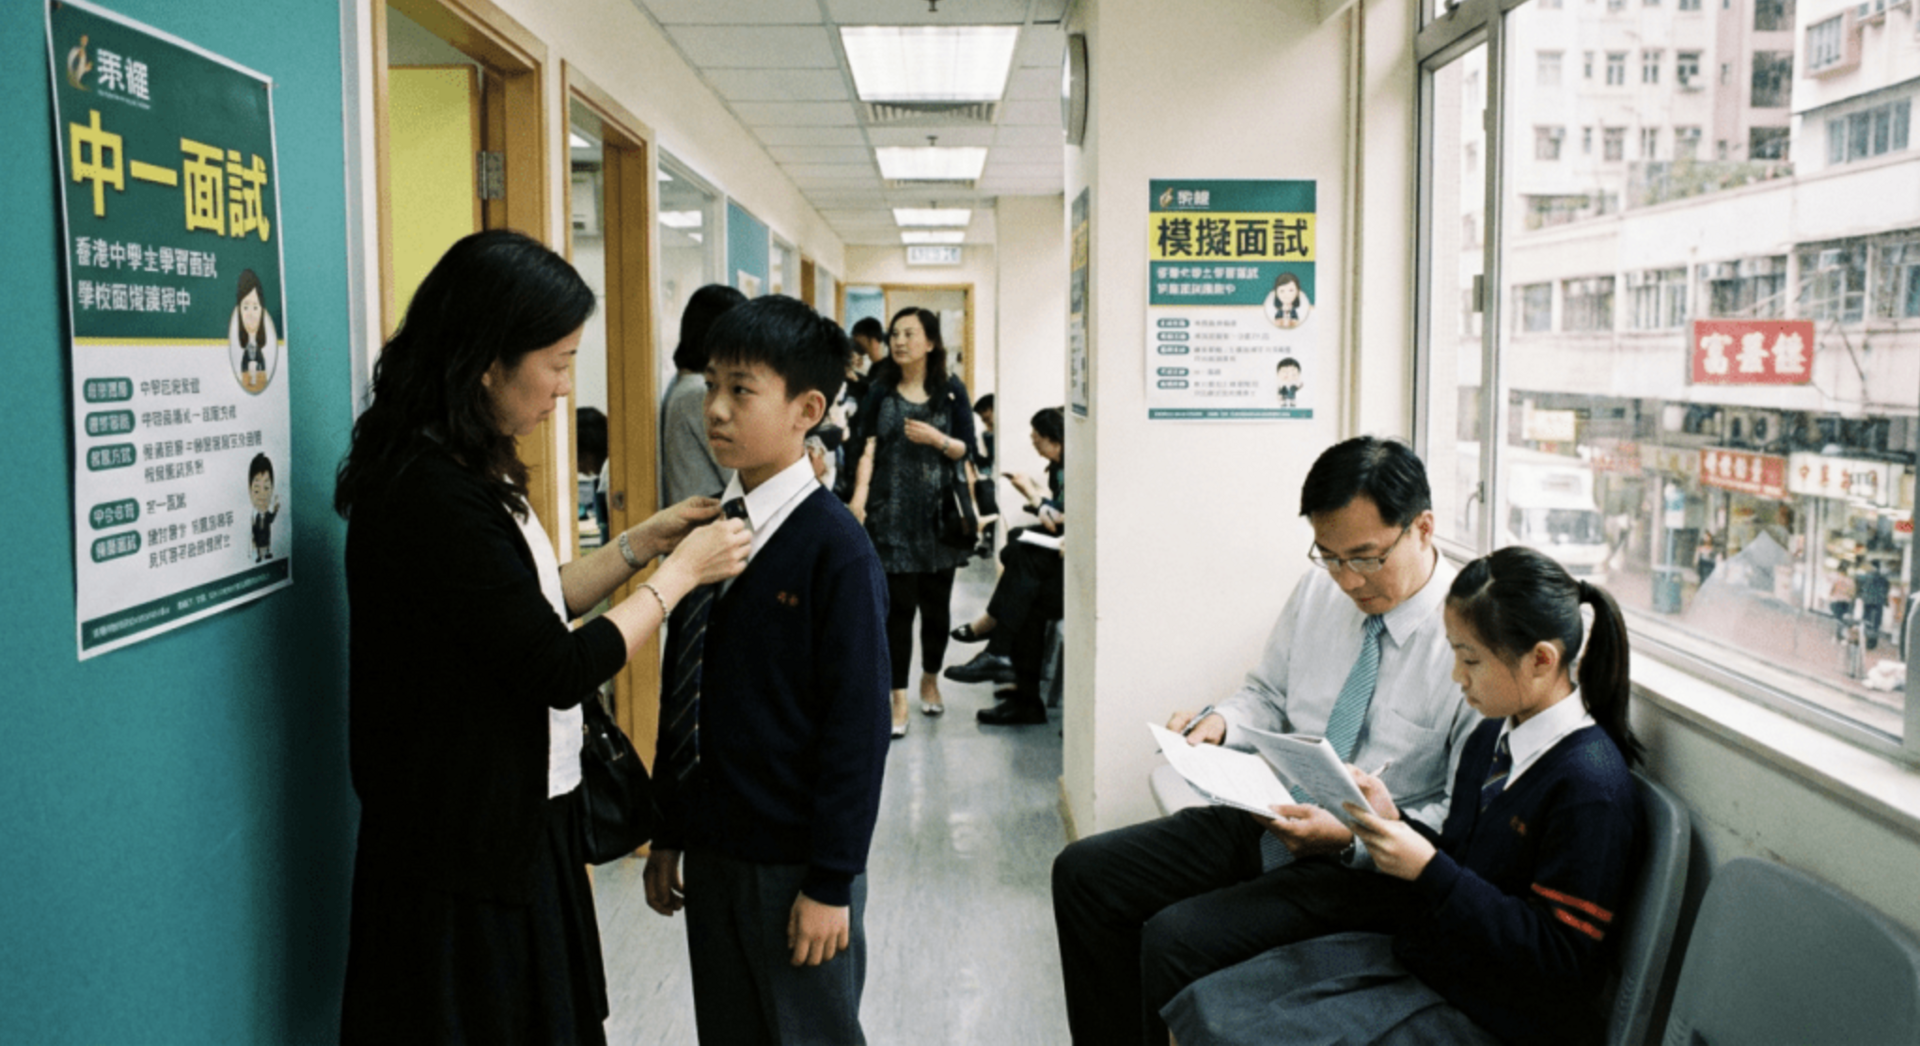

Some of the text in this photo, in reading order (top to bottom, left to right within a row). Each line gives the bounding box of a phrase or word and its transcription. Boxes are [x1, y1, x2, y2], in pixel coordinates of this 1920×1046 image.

[69, 109, 270, 242] 中一面試
[1157, 217, 1308, 257] 模擬面試
